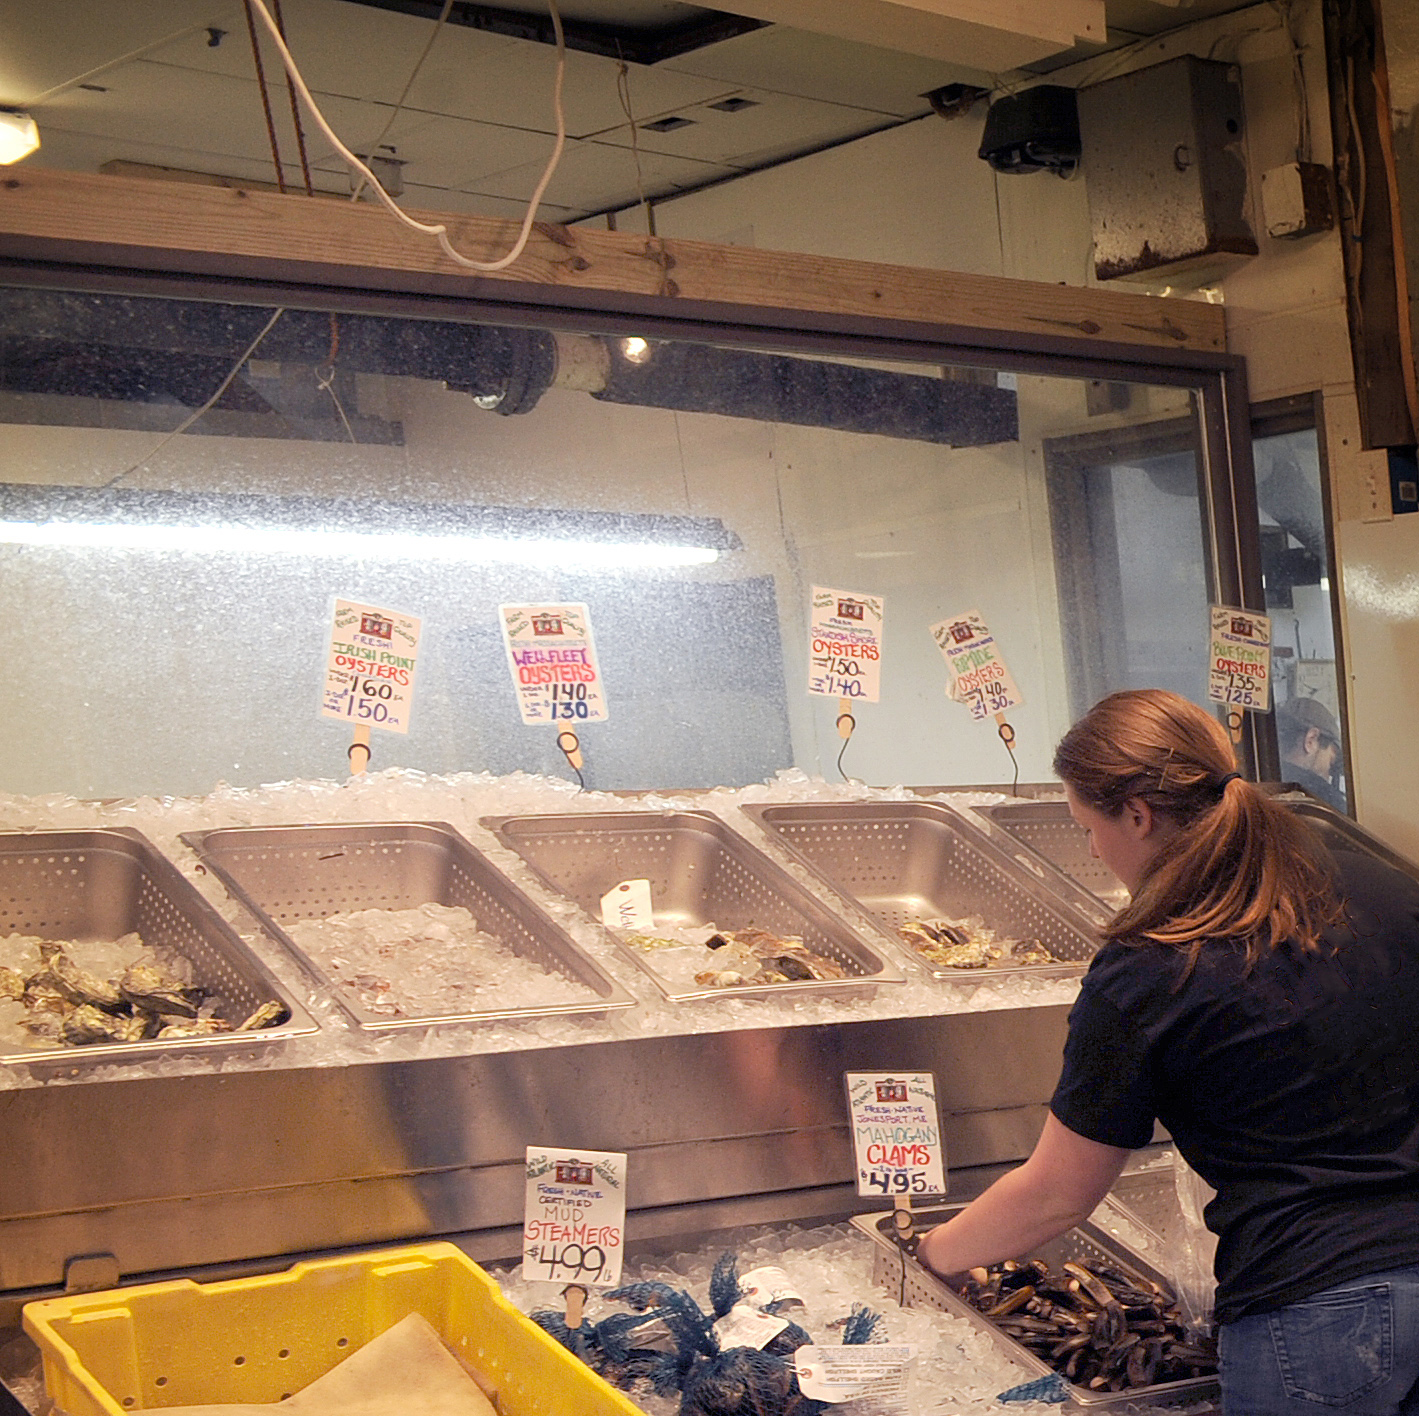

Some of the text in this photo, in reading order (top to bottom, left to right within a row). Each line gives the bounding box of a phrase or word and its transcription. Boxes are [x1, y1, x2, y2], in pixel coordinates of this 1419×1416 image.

[332, 641, 416, 671] IRISH POINT
[512, 648, 587, 667] WELLFLEET
[812, 638, 881, 662] OYSTERS
[335, 655, 409, 687] OYSTERS
[519, 663, 597, 685] OYSTERS
[957, 660, 1005, 692] OYSTERS
[1216, 657, 1267, 680] OYSTERS
[856, 1113, 909, 1124] JONESPORT
[856, 1126, 937, 1147] MAHOGANY
[866, 1143, 931, 1168] CLAMS
[600, 1159, 619, 1176] ALL
[537, 1183, 604, 1200] FRESH NATIVE
[928, 1184, 940, 1192] EA
[538, 1195, 593, 1209] CERTIFIED
[543, 1205, 585, 1223] MUD
[524, 1219, 621, 1248] STEAMERS
